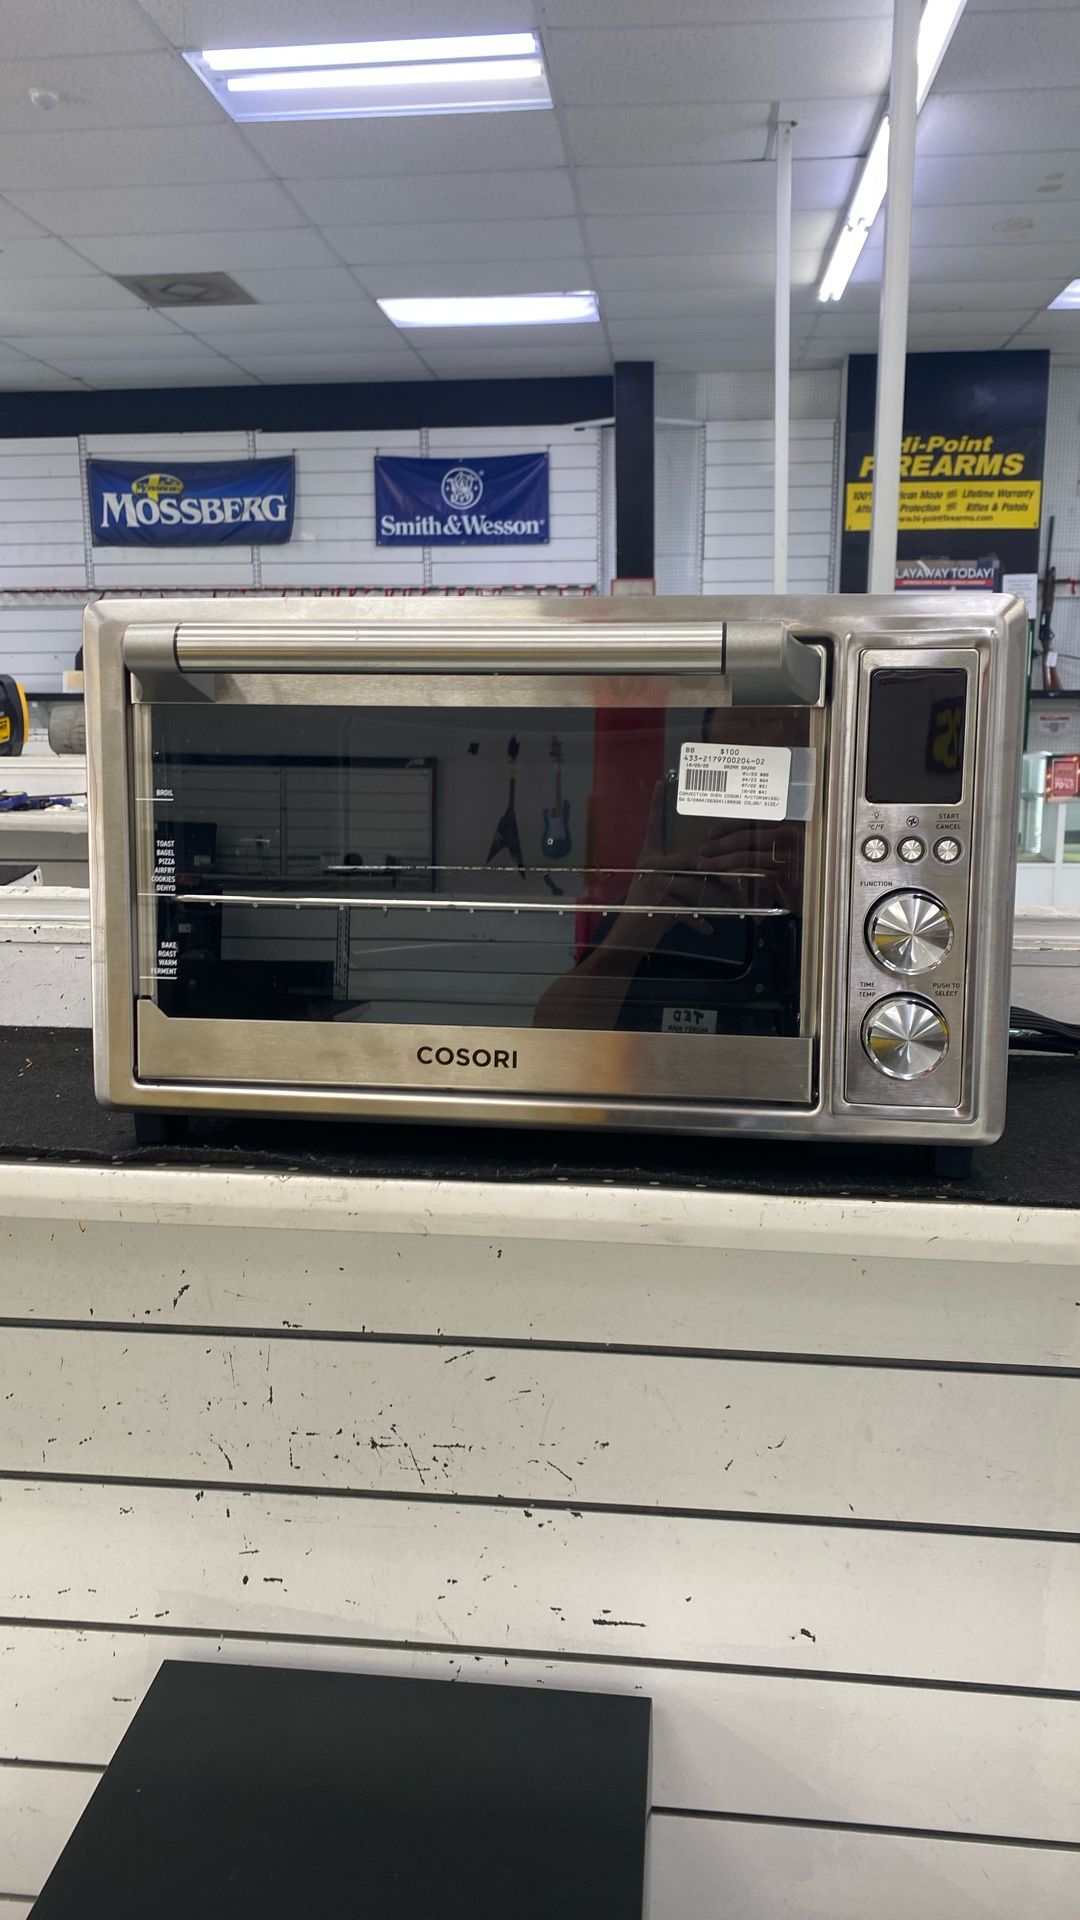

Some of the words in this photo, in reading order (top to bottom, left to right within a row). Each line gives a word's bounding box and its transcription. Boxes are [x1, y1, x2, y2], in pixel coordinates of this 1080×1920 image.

[900, 435, 994, 453] Hi-Point
[859, 453, 1026, 478] FREARMS
[920, 490, 944, 499] Made
[962, 489, 995, 499] Lifetime
[998, 489, 1035, 500] Warranty
[100, 492, 288, 528] MOSSBERG
[899, 504, 941, 513] Protection
[966, 503, 989, 513] Rifles
[991, 502, 999, 512] &
[1001, 503, 1029, 512] Pistols
[896, 567, 949, 579] LAYAWAY
[952, 567, 994, 578] TODAY!
[720, 748, 740, 756] $100
[156, 789, 174, 797] BROIL
[151, 875, 176, 883] COOKIES
[156, 884, 177, 892] DEHYD
[859, 880, 893, 888] FUNCTION
[161, 941, 177, 949] BAKE
[151, 967, 178, 975] FERMENT
[416, 1045, 518, 1069] COSORI
